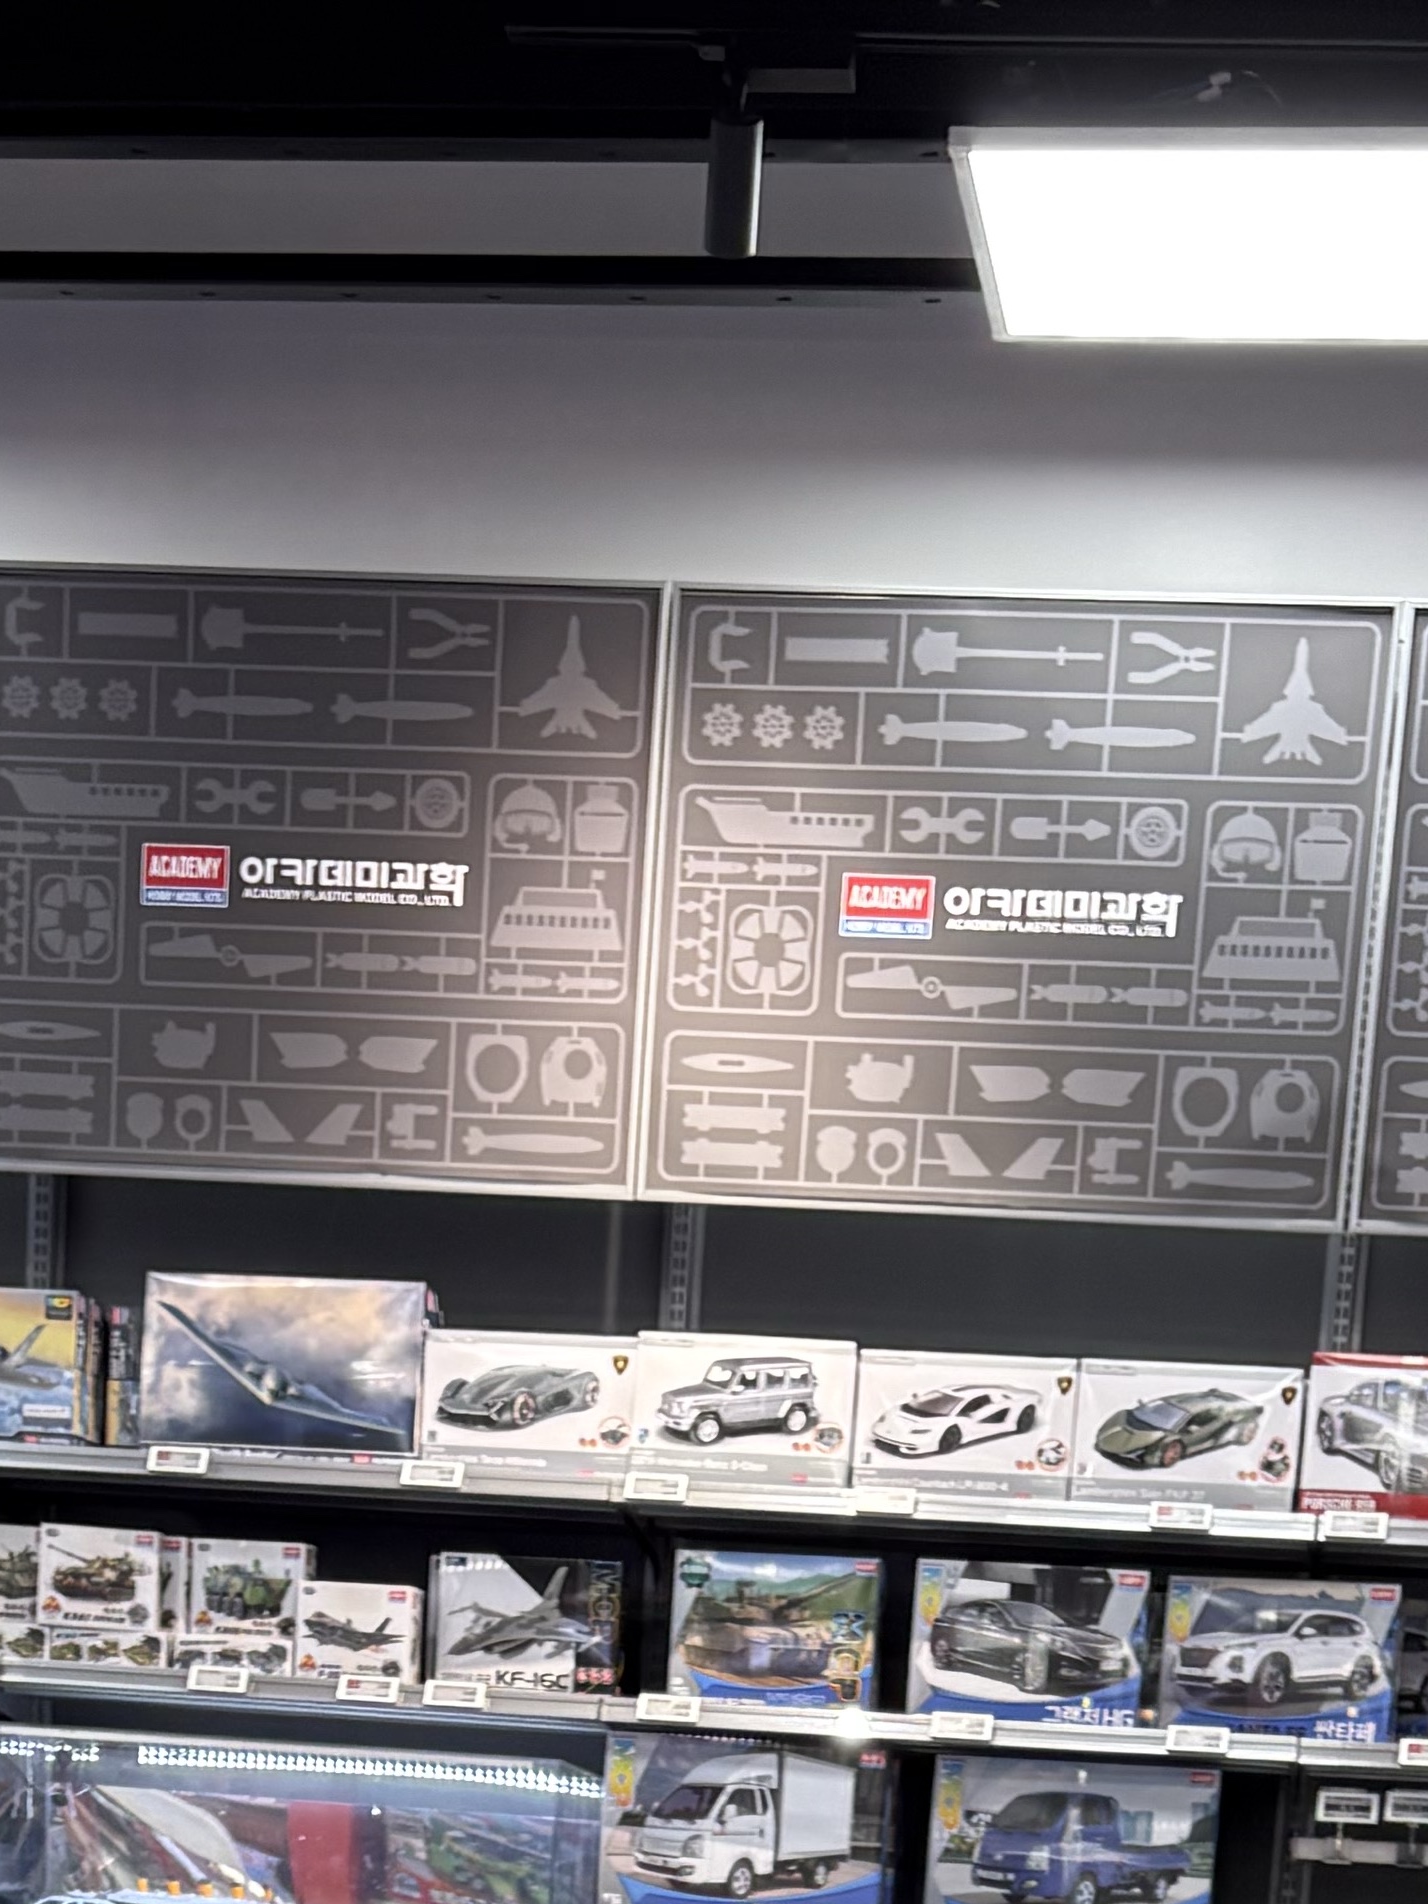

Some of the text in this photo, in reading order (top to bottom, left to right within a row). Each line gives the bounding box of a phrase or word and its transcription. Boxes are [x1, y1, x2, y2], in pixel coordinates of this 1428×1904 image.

[148, 854, 223, 879] ACADEMY
[239, 856, 469, 907] 아카데미과학
[849, 884, 927, 910] ACADEMY
[944, 886, 1183, 937] 아카데미과학
[495, 1670, 569, 1690] KF-16C
